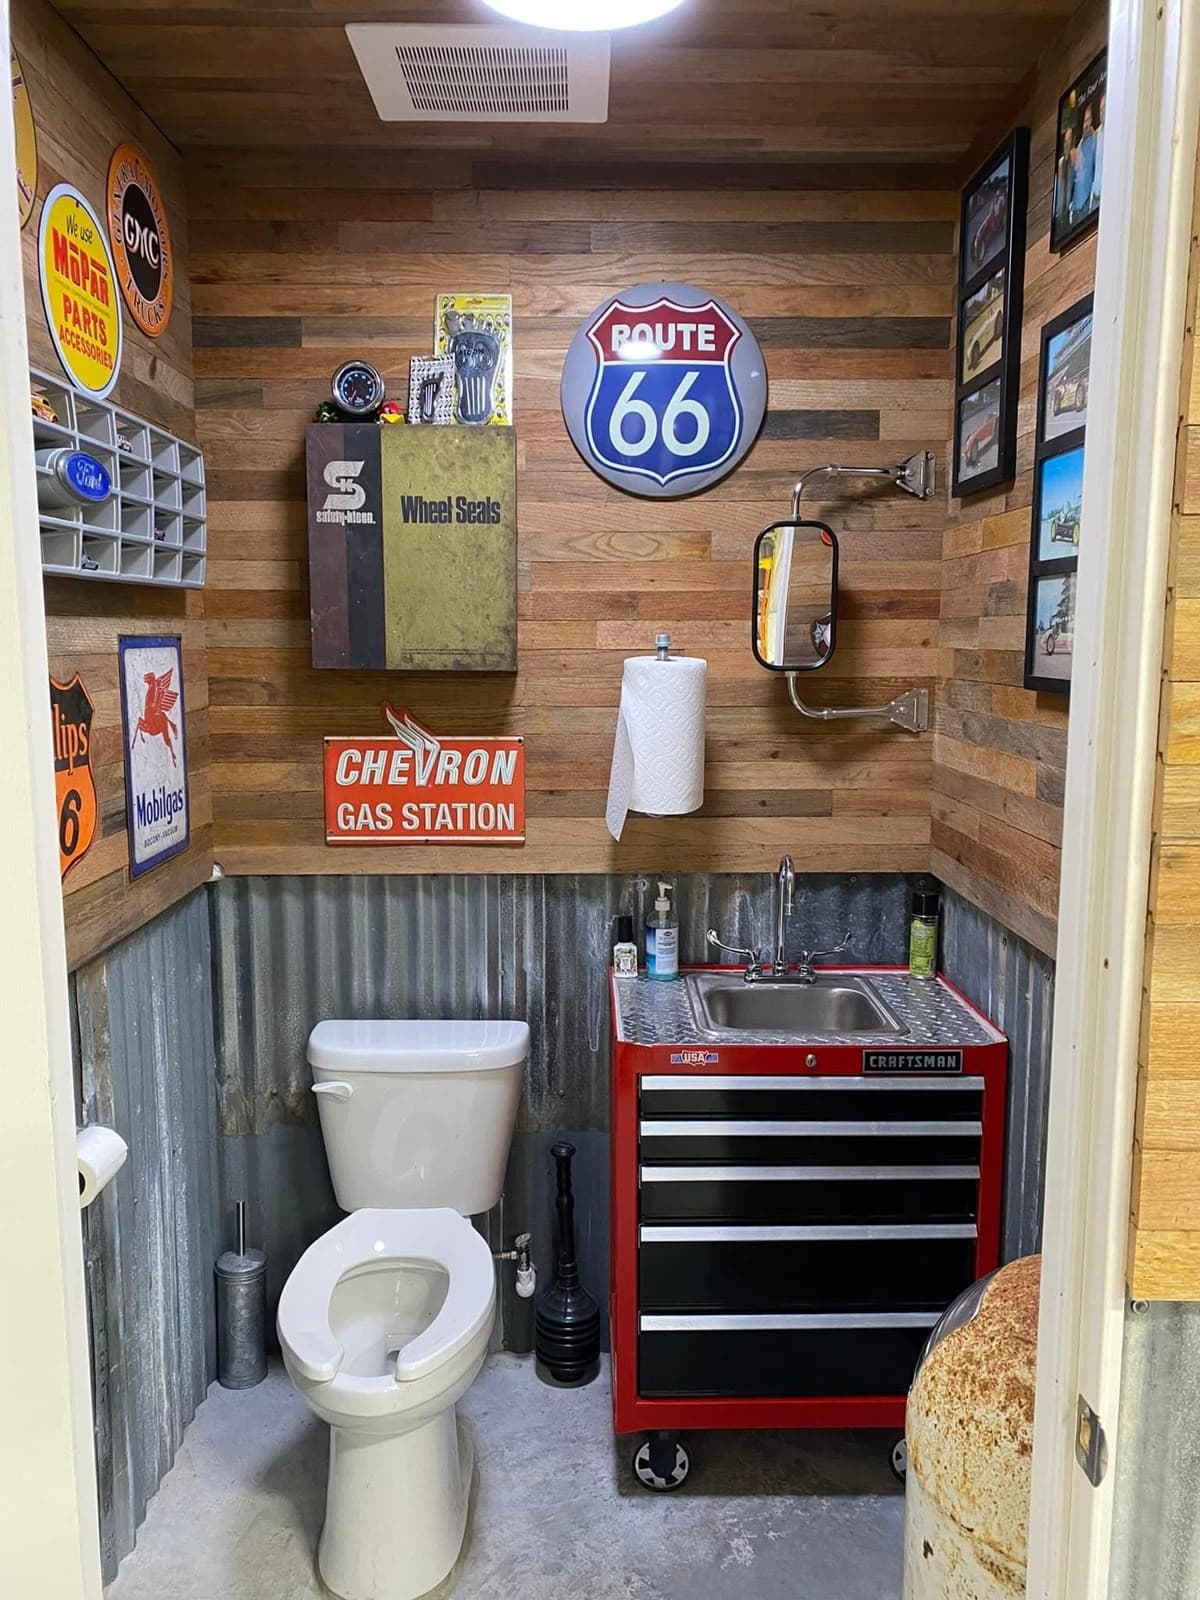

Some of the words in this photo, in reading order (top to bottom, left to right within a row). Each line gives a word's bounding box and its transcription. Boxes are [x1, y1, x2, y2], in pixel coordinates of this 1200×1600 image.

[66, 213, 78, 238] We
[80, 225, 93, 245] use
[124, 212, 161, 270] GMC
[62, 292, 108, 346] PARTS
[611, 323, 716, 351] ROUTE
[59, 324, 114, 371] ACCESSORIES
[609, 371, 710, 457] 66
[75, 459, 103, 490] Ford
[400, 496, 452, 524] Wheel
[456, 496, 501, 525] Seals
[53, 703, 88, 776] lips
[336, 740, 519, 787] CHEVRON
[136, 785, 184, 829] Mobilgas
[336, 802, 394, 832] GAS
[401, 802, 515, 832] STATION
[684, 1052, 705, 1063] USA
[869, 1055, 956, 1068] CRAFTSMAN
